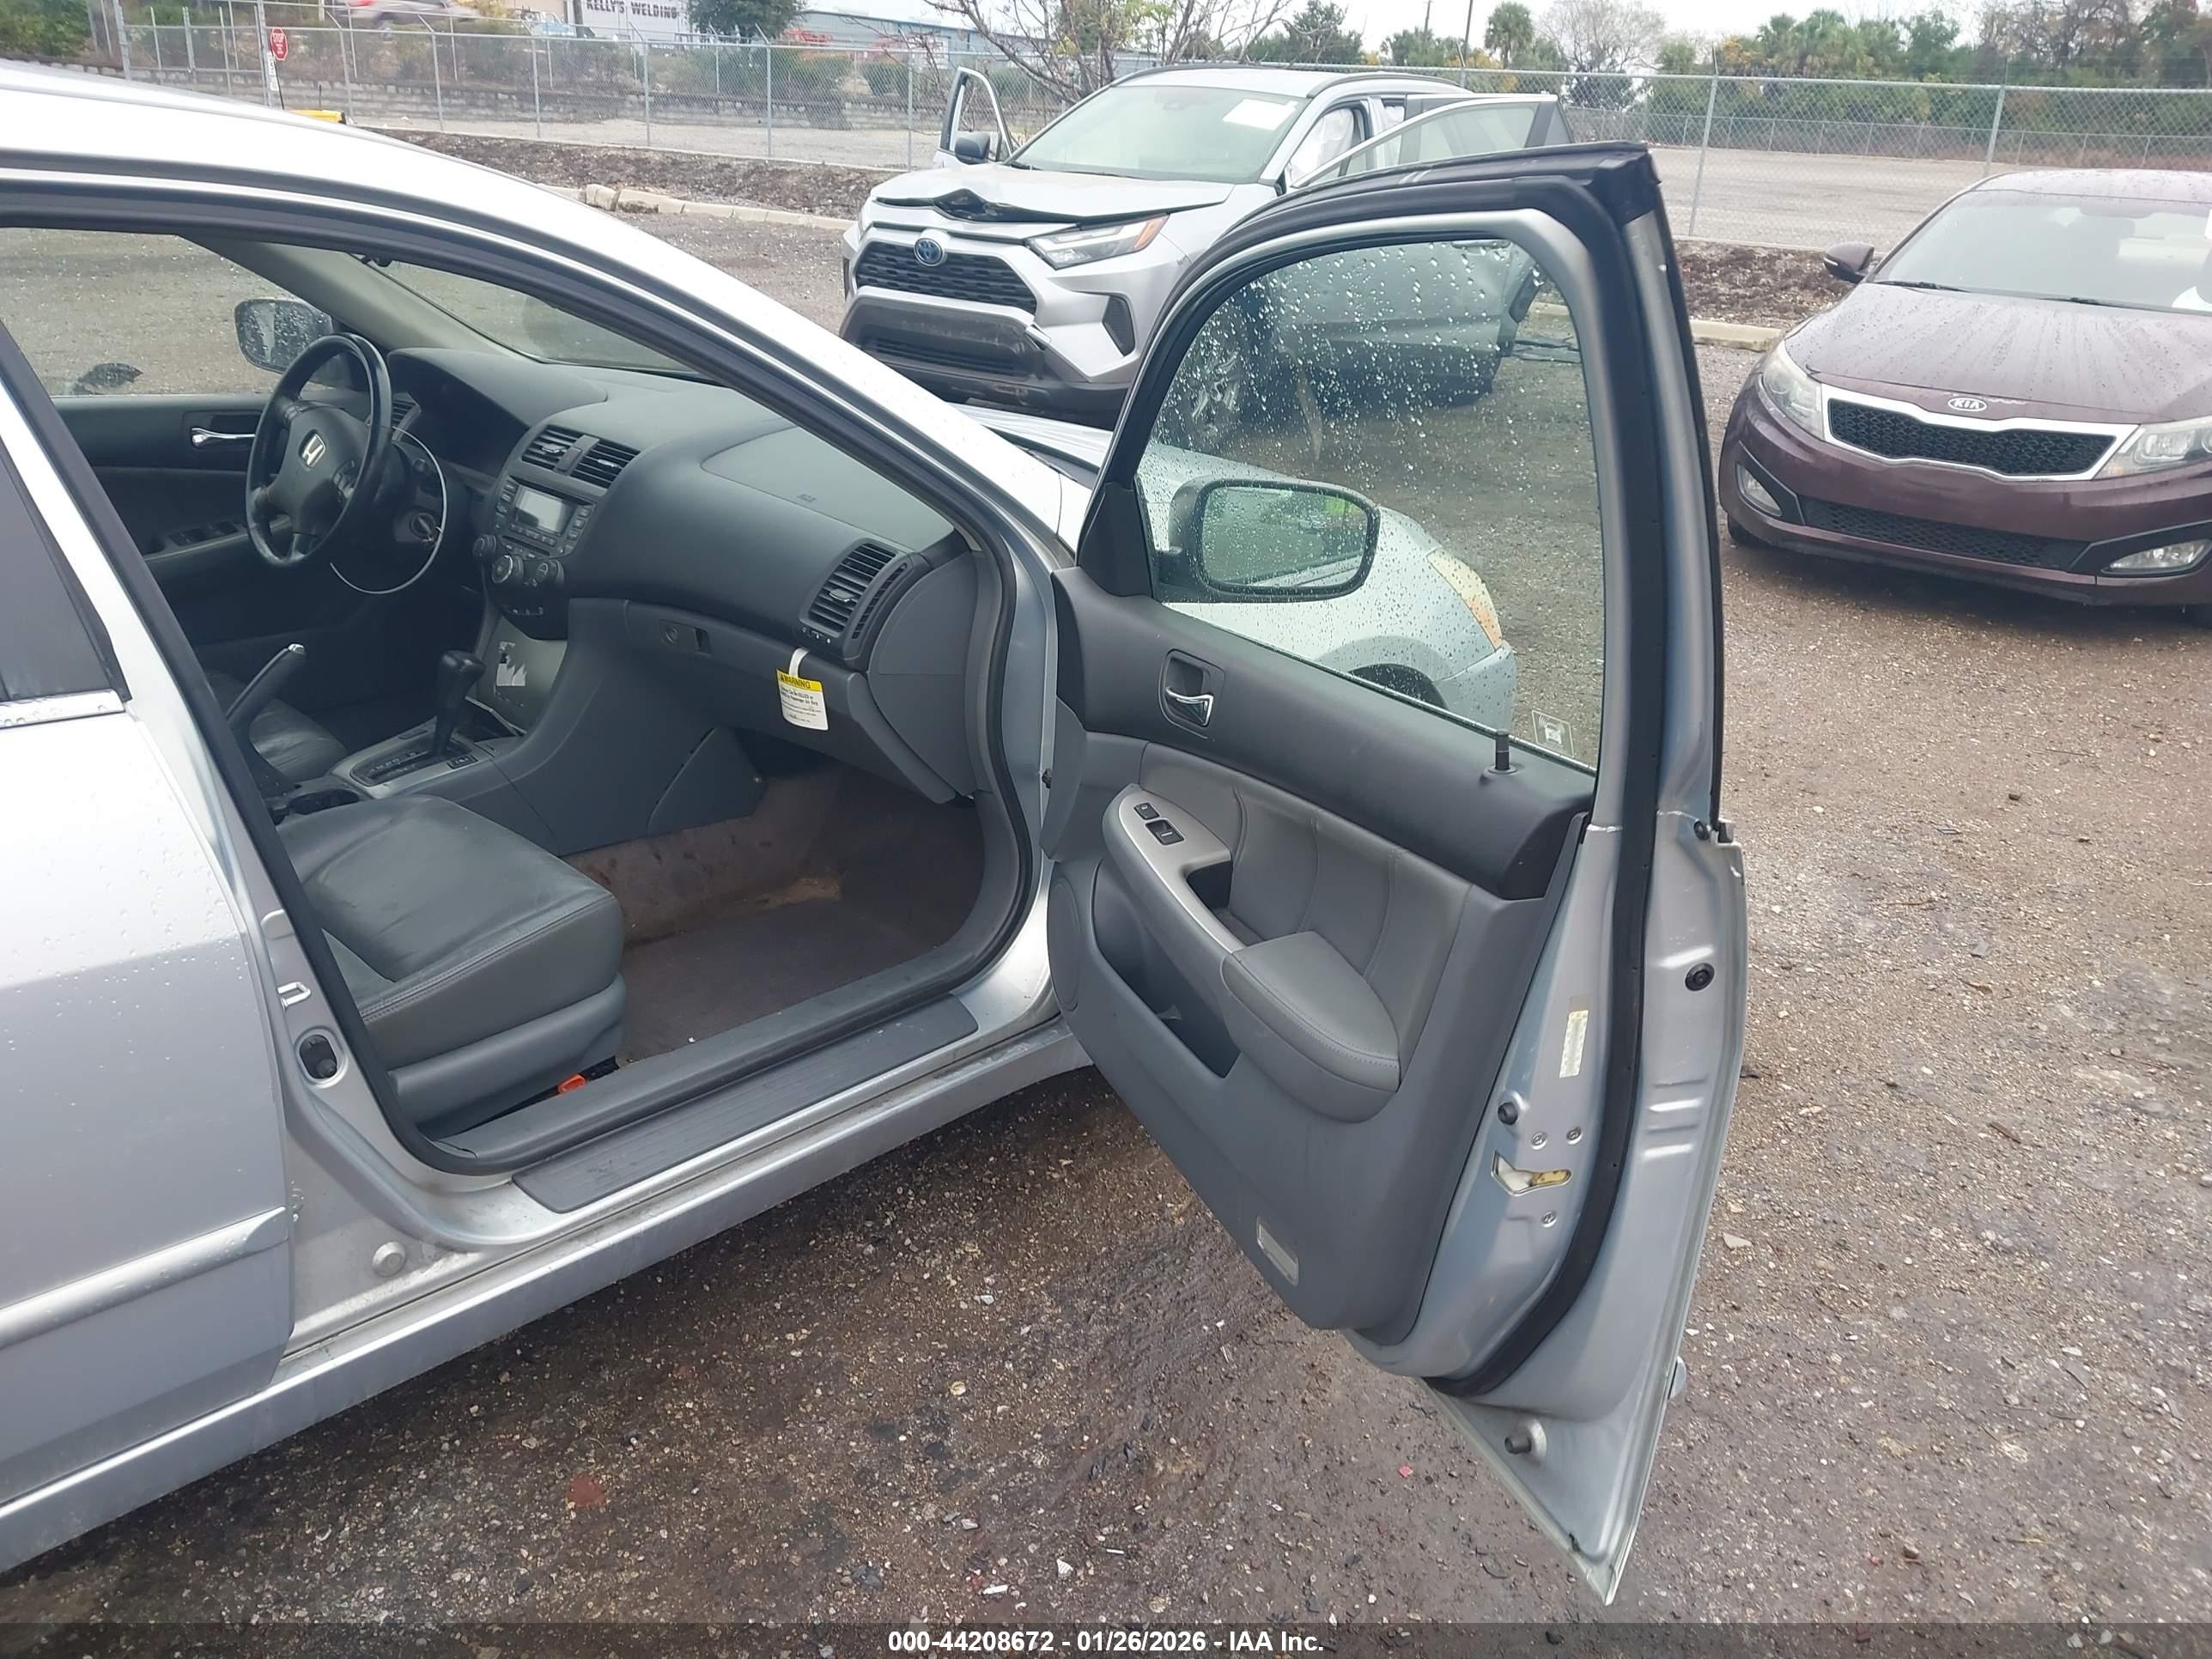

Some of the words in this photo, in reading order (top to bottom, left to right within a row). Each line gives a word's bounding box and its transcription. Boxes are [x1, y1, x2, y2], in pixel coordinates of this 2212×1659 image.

[586, 0, 625, 14] KELLY'S
[630, 1, 678, 19] WELDING
[272, 33, 284, 43] STOP
[1954, 398, 1980, 410] KIA
[784, 675, 811, 690] WARNING
